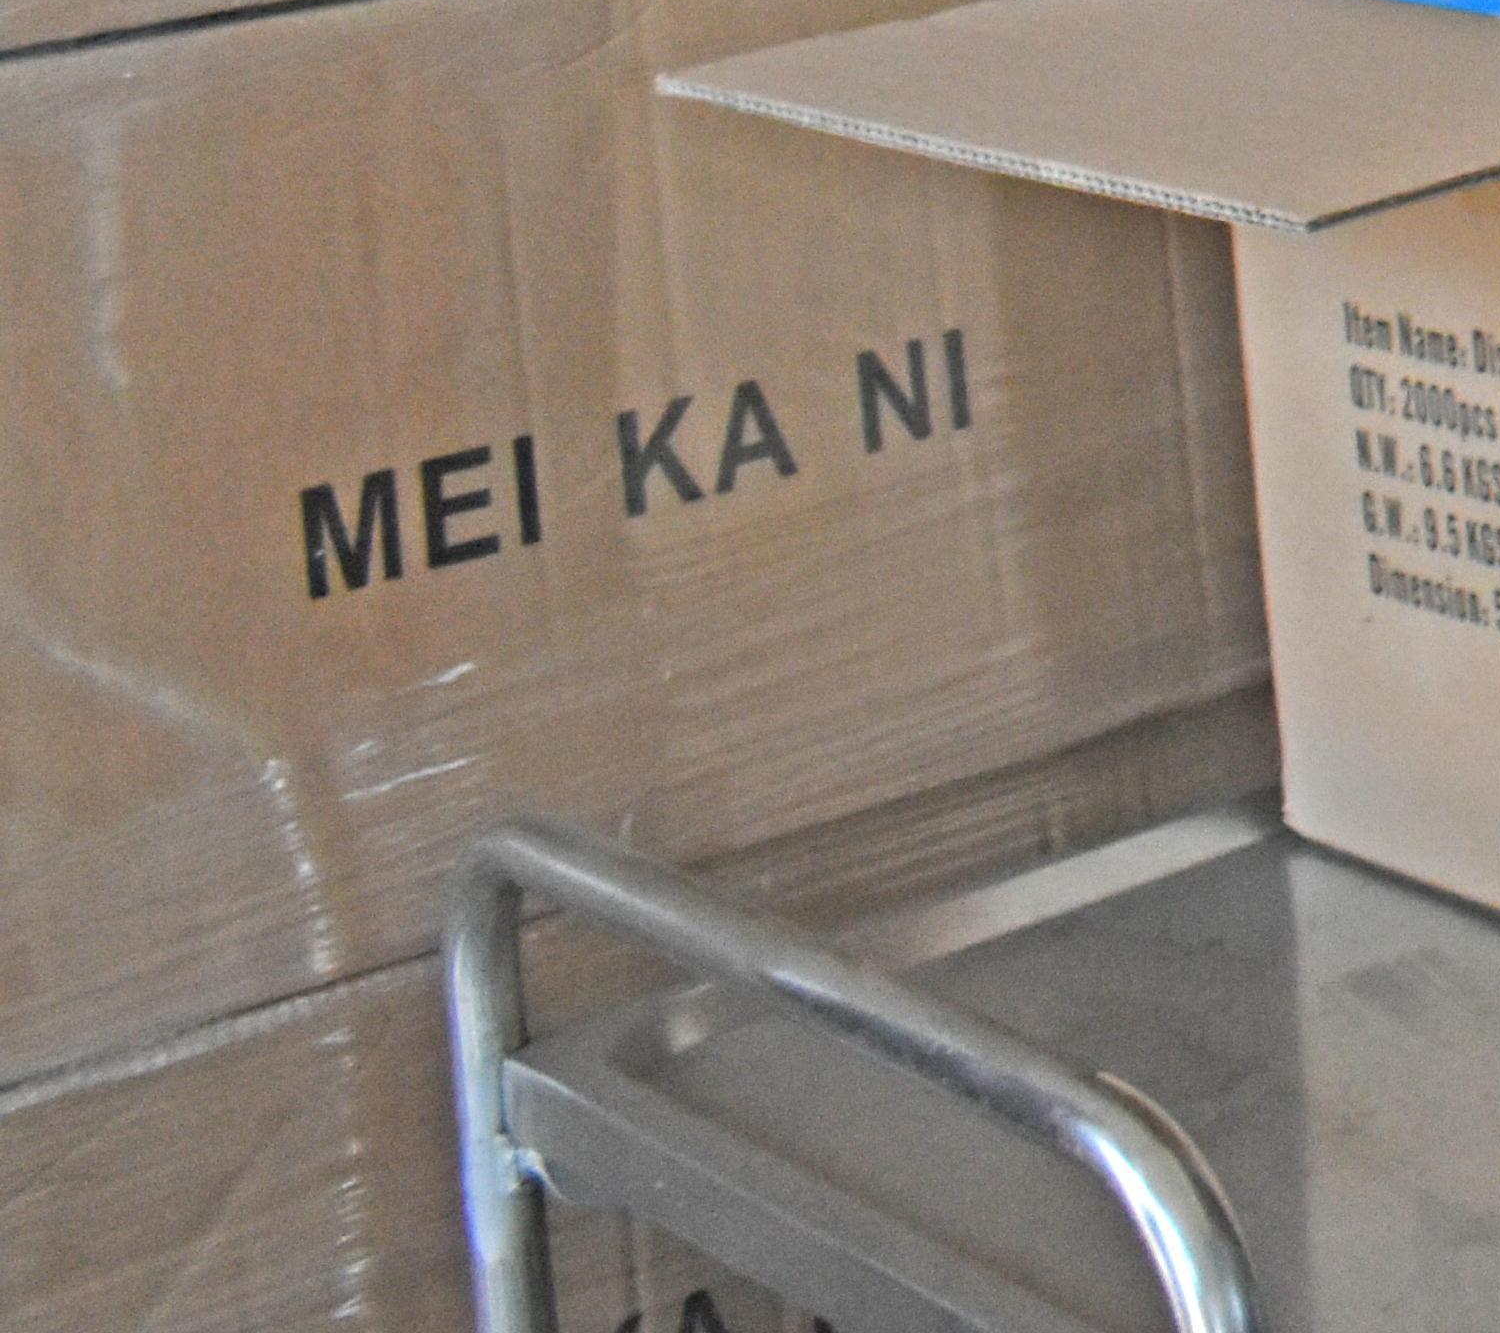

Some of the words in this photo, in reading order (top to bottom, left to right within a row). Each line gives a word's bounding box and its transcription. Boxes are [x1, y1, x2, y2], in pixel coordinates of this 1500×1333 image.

[1343, 300, 1393, 352] Item
[1401, 376, 1498, 441] 2000pcs
[298, 434, 542, 601] MEI
[614, 378, 799, 519] KA
[855, 328, 973, 455] NI
